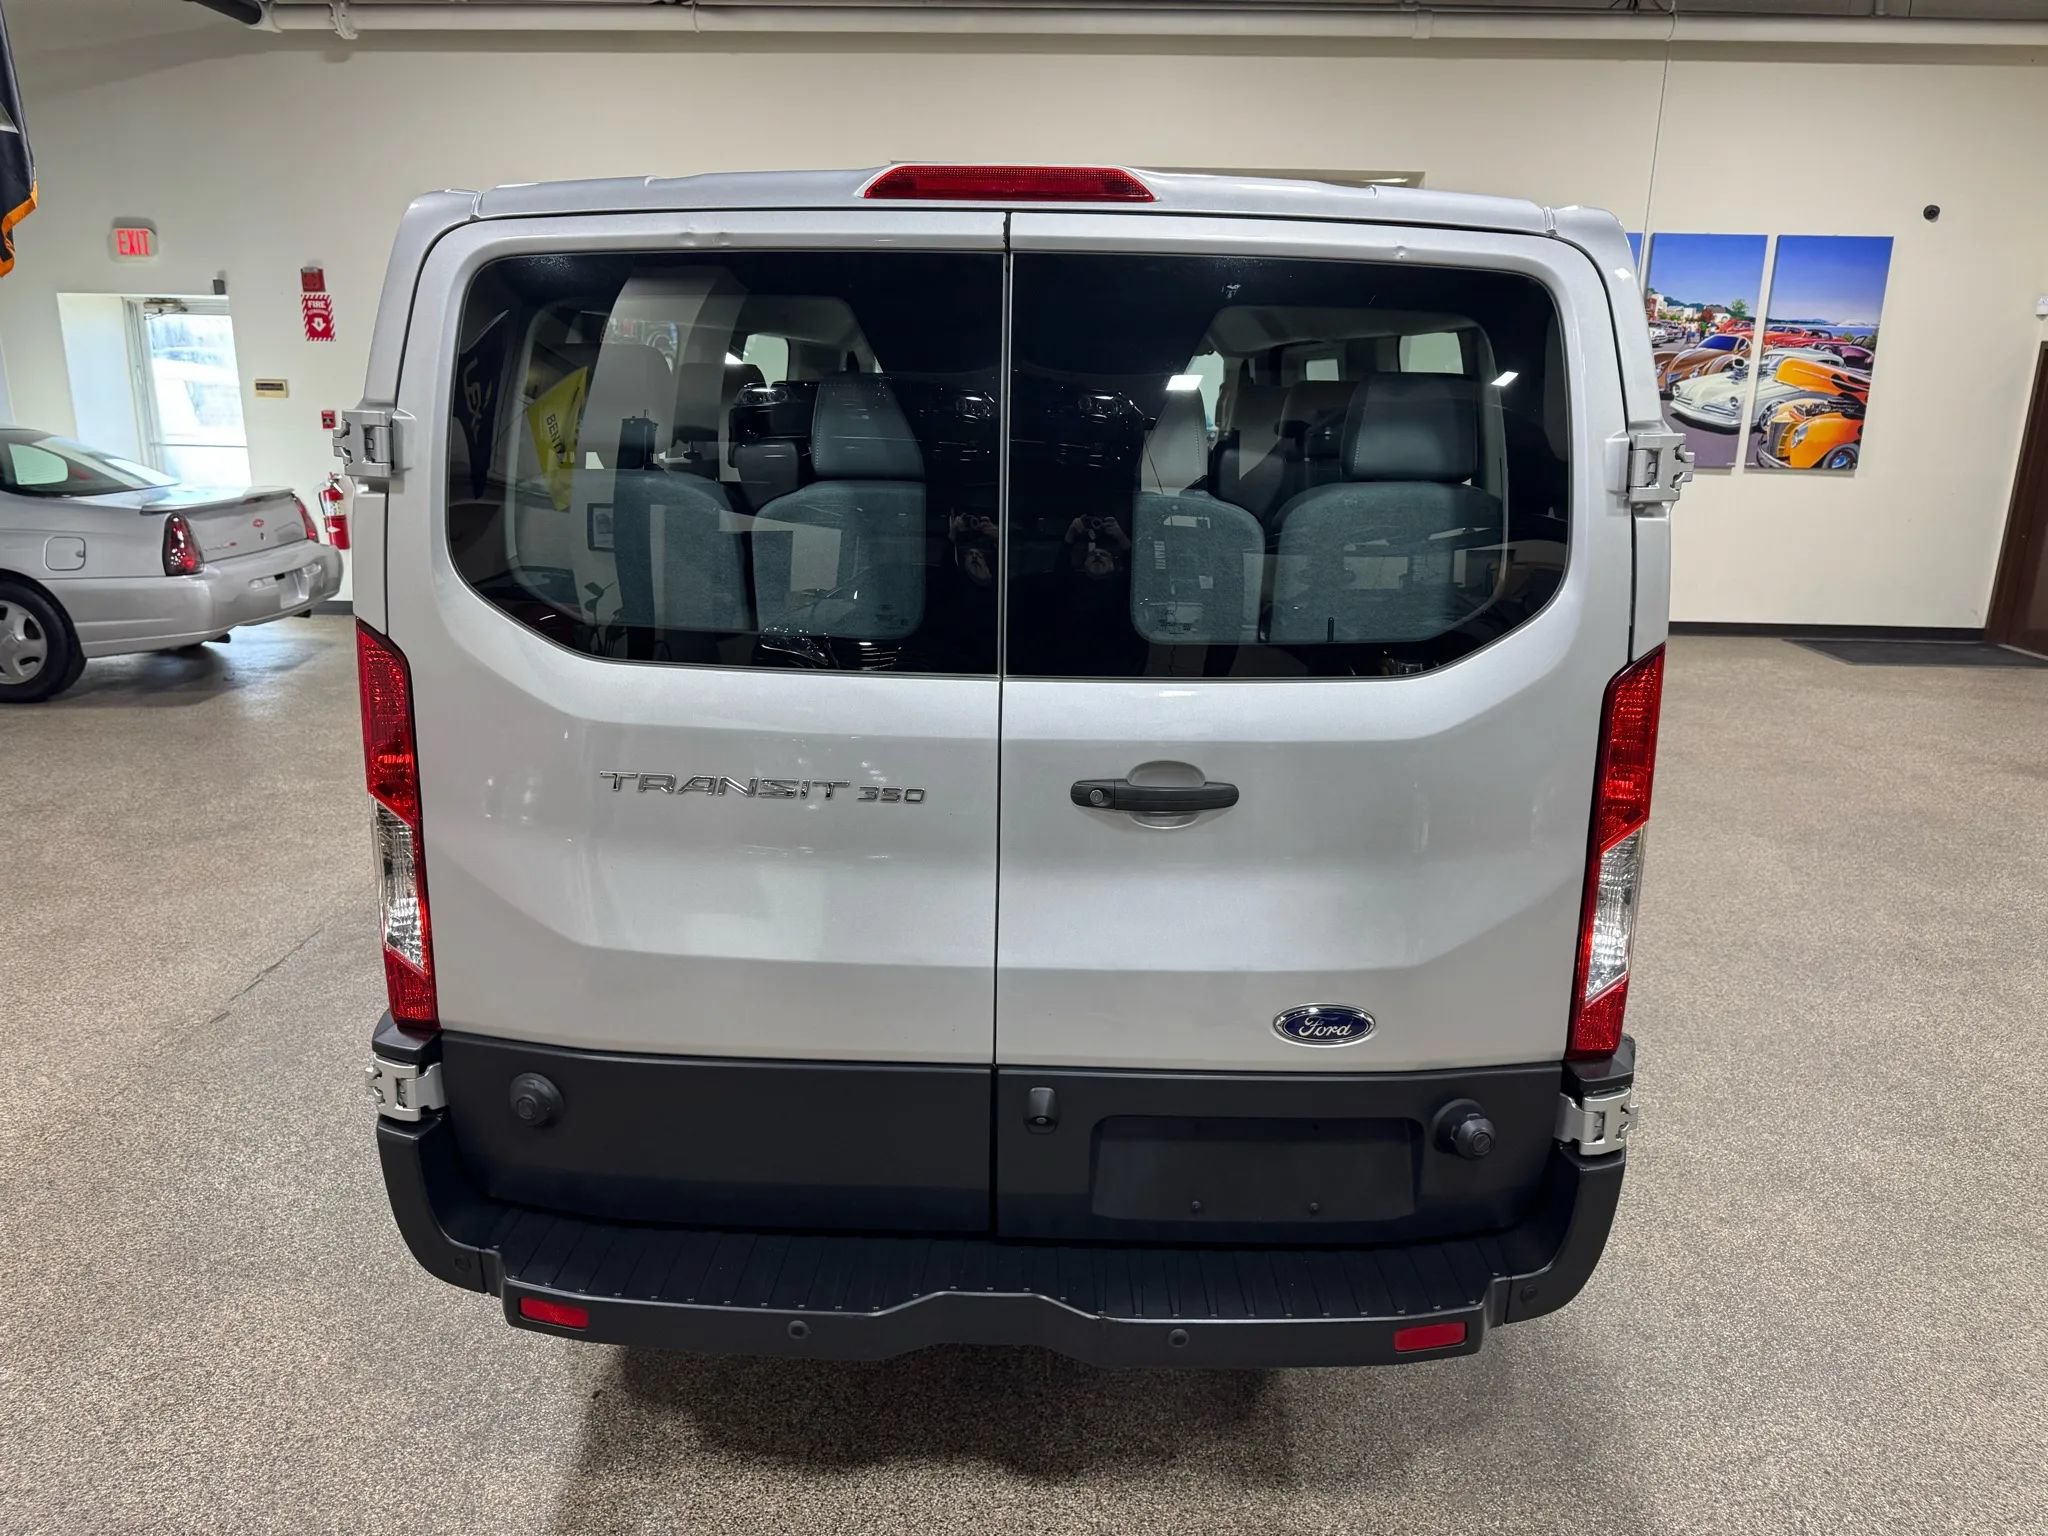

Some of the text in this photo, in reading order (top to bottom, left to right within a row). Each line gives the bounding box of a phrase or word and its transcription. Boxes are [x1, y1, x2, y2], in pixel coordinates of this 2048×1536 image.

[117, 229, 150, 257] EXIT
[307, 300, 328, 309] FIRE
[600, 770, 926, 804] TRANSIT 350
[1298, 1014, 1354, 1037] Ford
